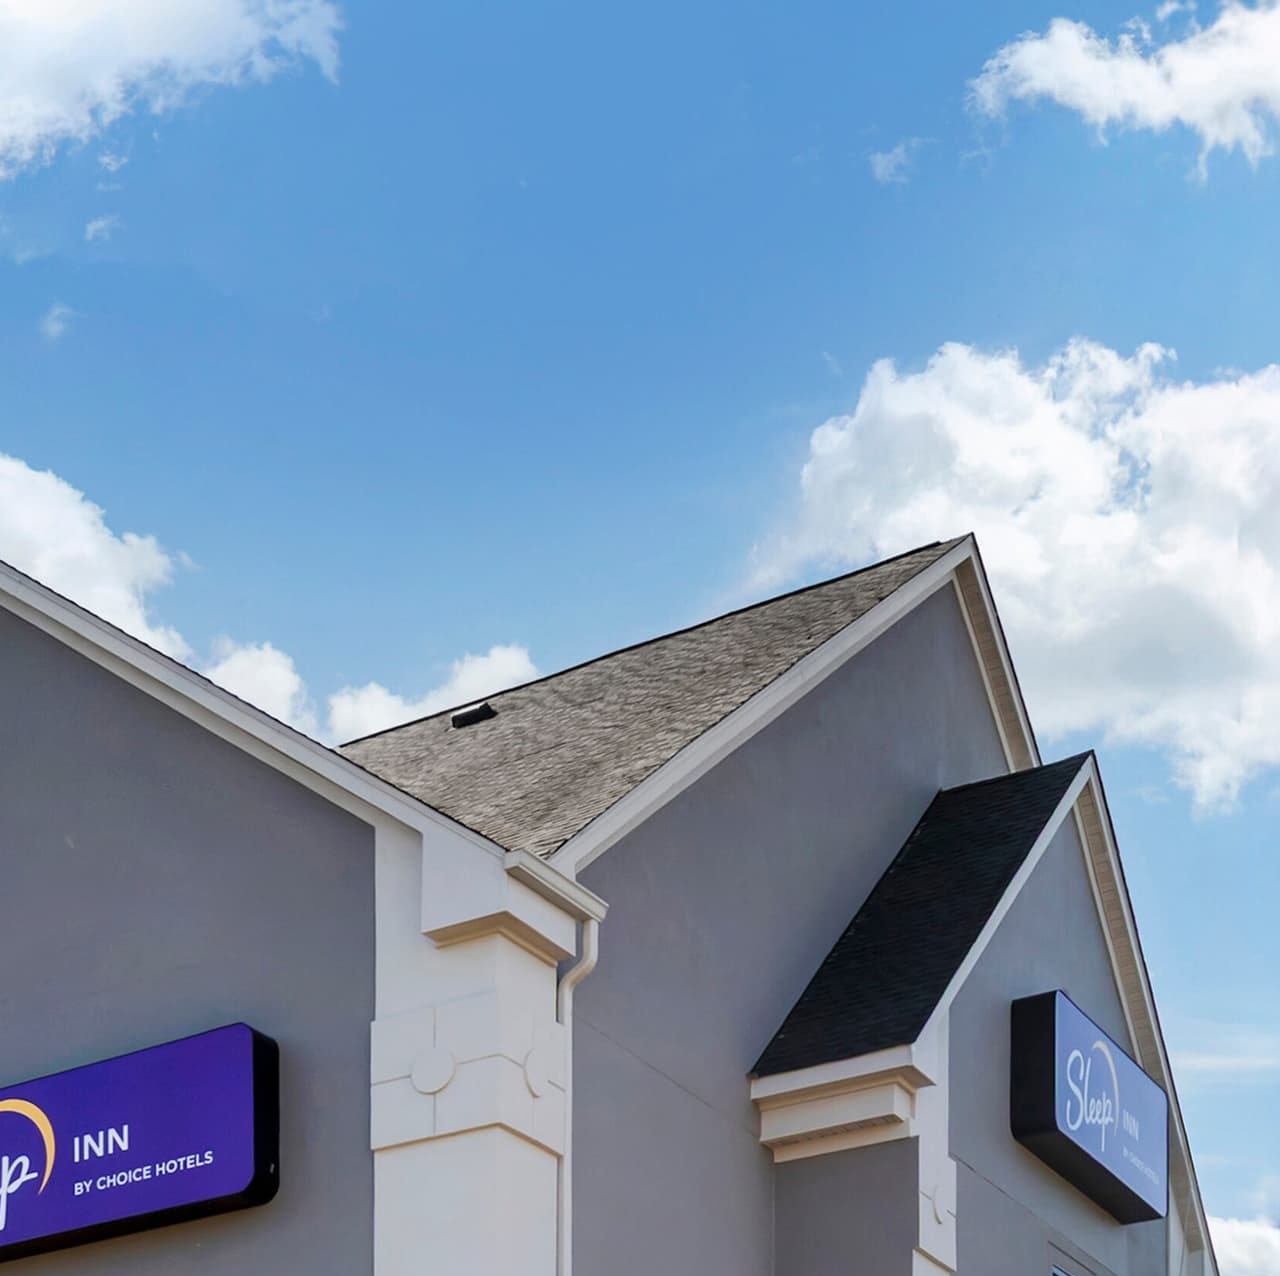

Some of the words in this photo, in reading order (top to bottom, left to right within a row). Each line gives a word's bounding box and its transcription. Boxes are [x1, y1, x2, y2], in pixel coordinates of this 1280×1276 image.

[1066, 1049, 1115, 1152] Sleep
[72, 1124, 130, 1163] INN
[73, 1180, 94, 1196] BY
[96, 1164, 152, 1191] CHOICE
[154, 1150, 216, 1176] HOTELS
